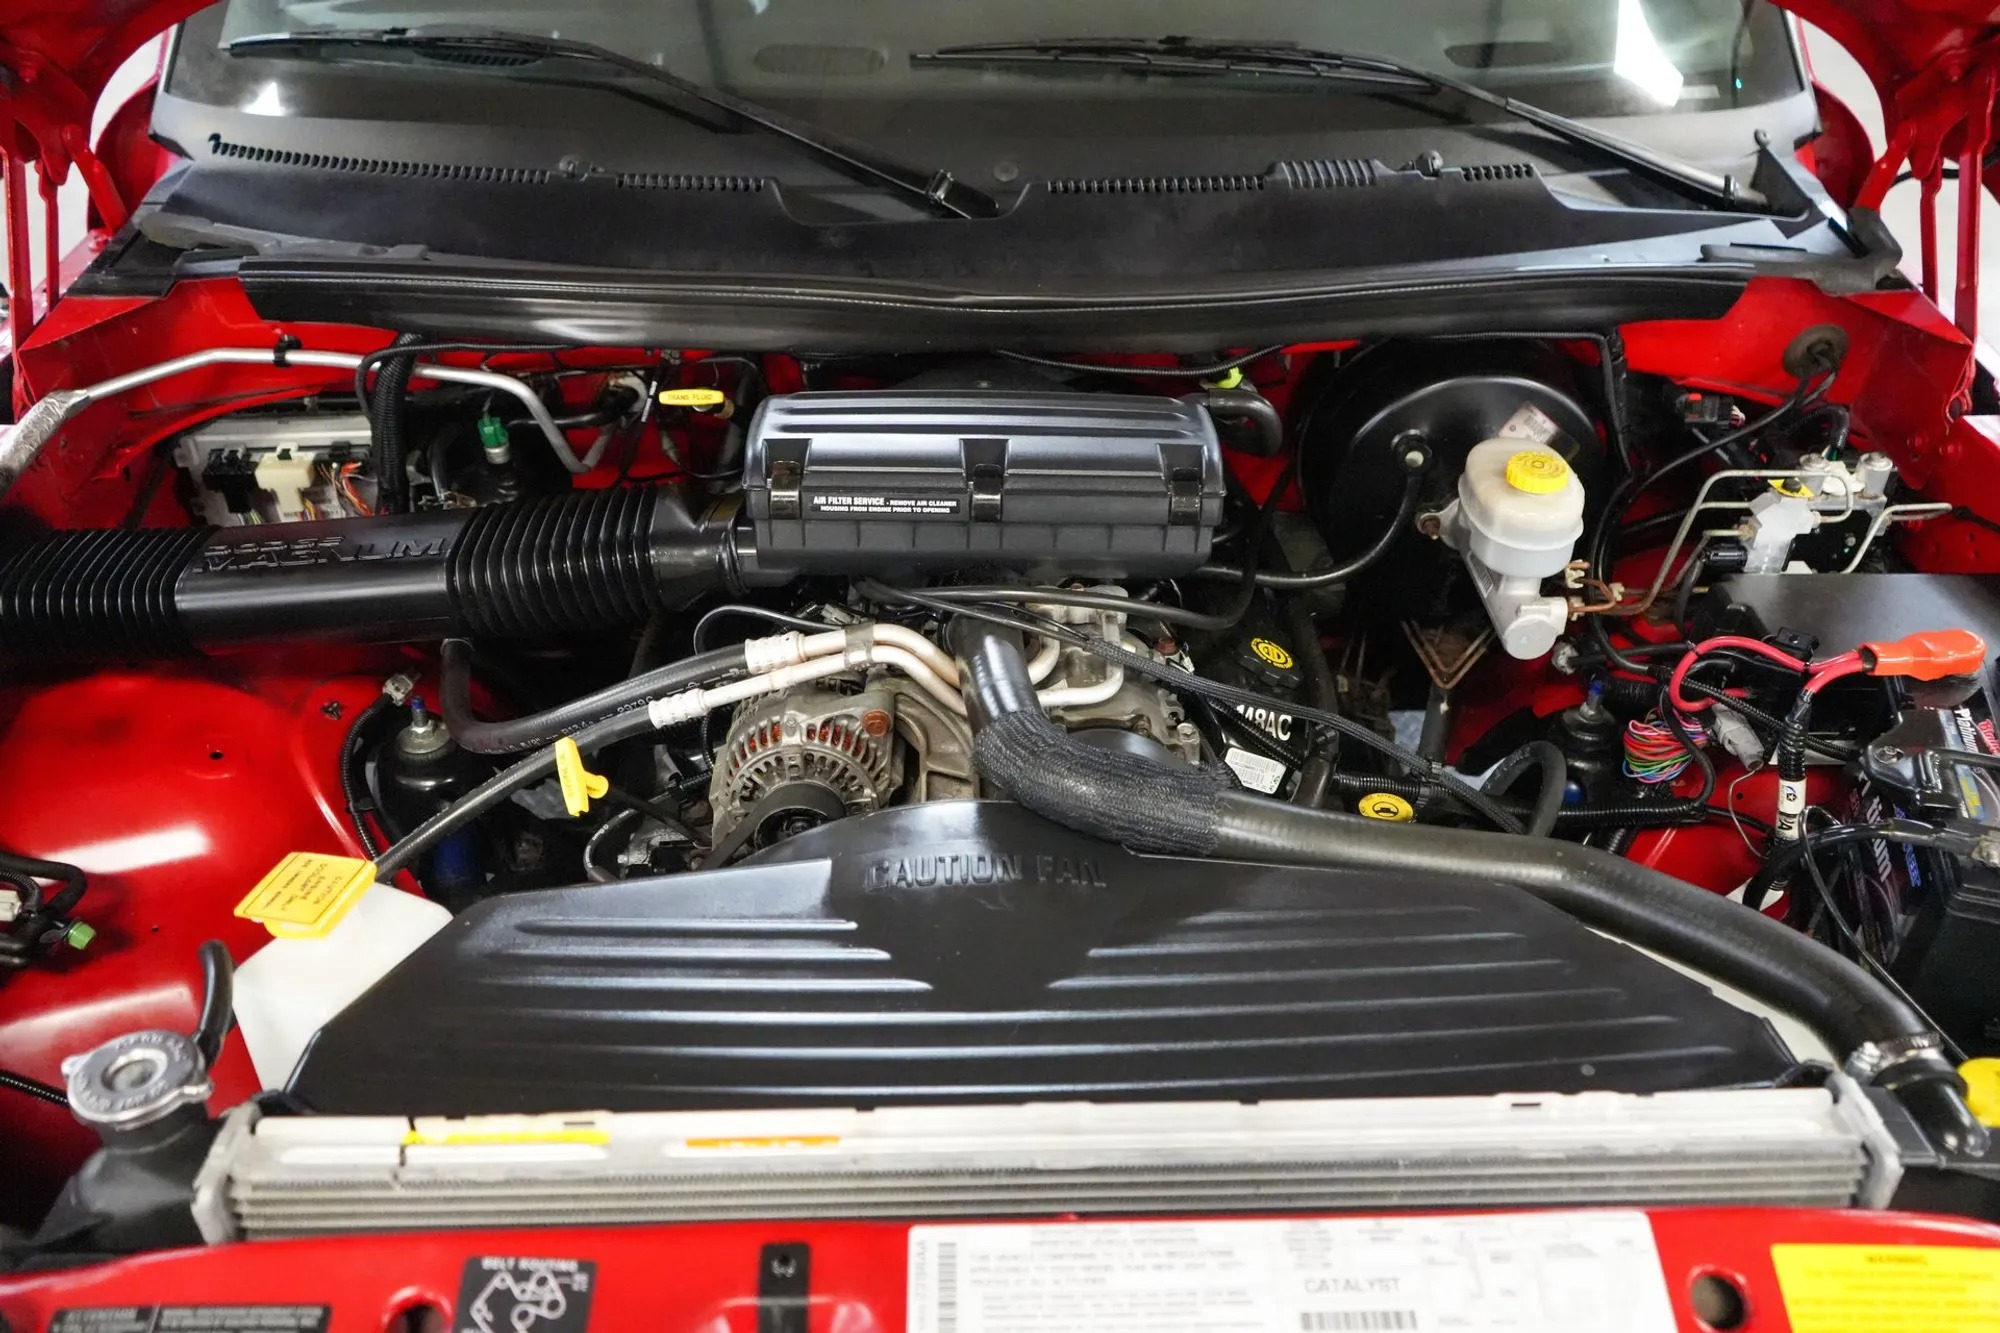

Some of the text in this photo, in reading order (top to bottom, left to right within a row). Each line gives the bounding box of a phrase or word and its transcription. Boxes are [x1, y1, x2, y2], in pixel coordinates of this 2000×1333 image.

[813, 496, 826, 505] AIR
[828, 496, 852, 505] FILTER
[853, 497, 885, 506] SERVICE
[191, 537, 447, 573] MAGNUM
[1954, 707, 1979, 753] Platinum
[863, 853, 1107, 892] CAUTION FAN
[1304, 1277, 1401, 1295] CATALYST
